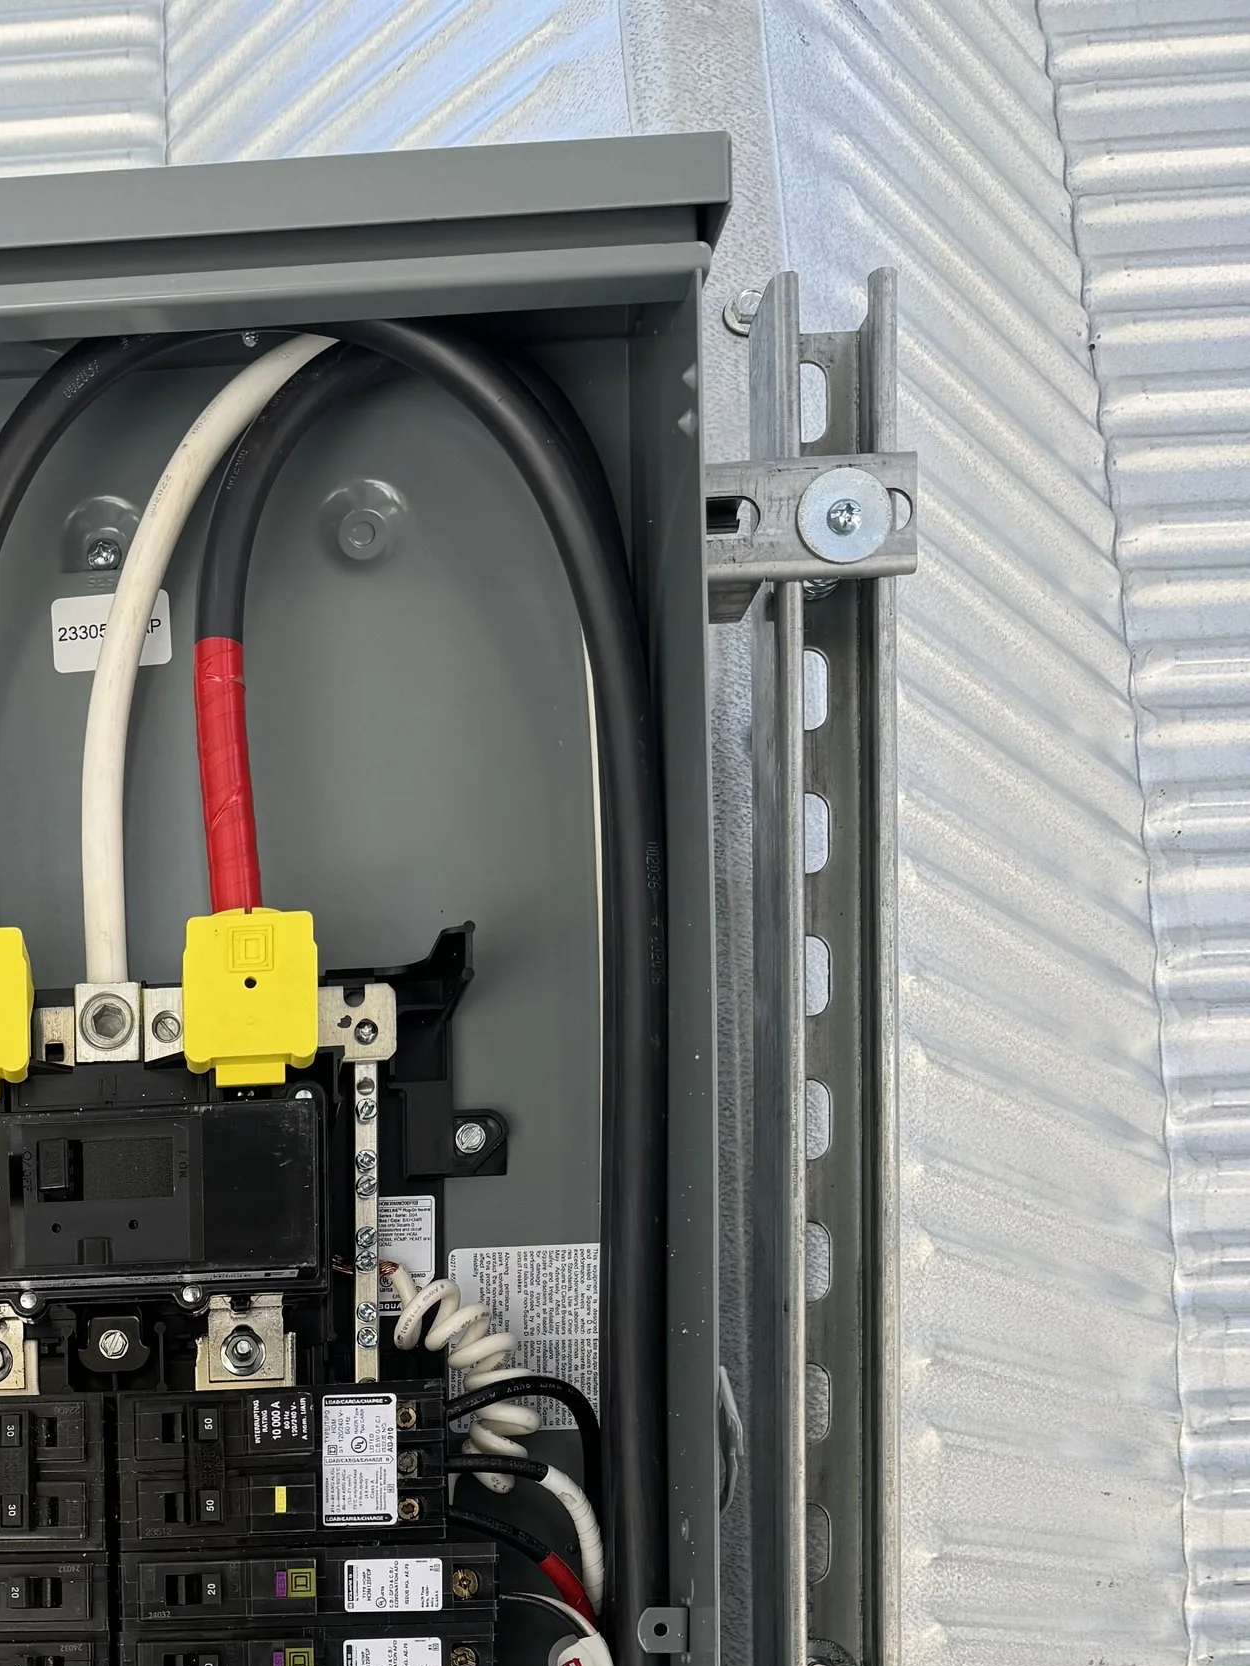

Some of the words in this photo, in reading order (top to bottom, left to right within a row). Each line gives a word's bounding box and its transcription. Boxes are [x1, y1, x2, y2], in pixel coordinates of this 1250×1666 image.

[205, 1418, 213, 1431] 50
[253, 1400, 261, 1444] INTERRUPTING
[261, 1410, 269, 1433] RATING
[271, 1411, 281, 1428] 000
[7, 1424, 15, 1437] 30
[271, 1429, 282, 1441] 10
[8, 1504, 16, 1517] 30
[206, 1500, 214, 1512] 50
[11, 1587, 19, 1599] 20
[207, 1583, 216, 1596] 20
[149, 1611, 171, 1619] 24032
